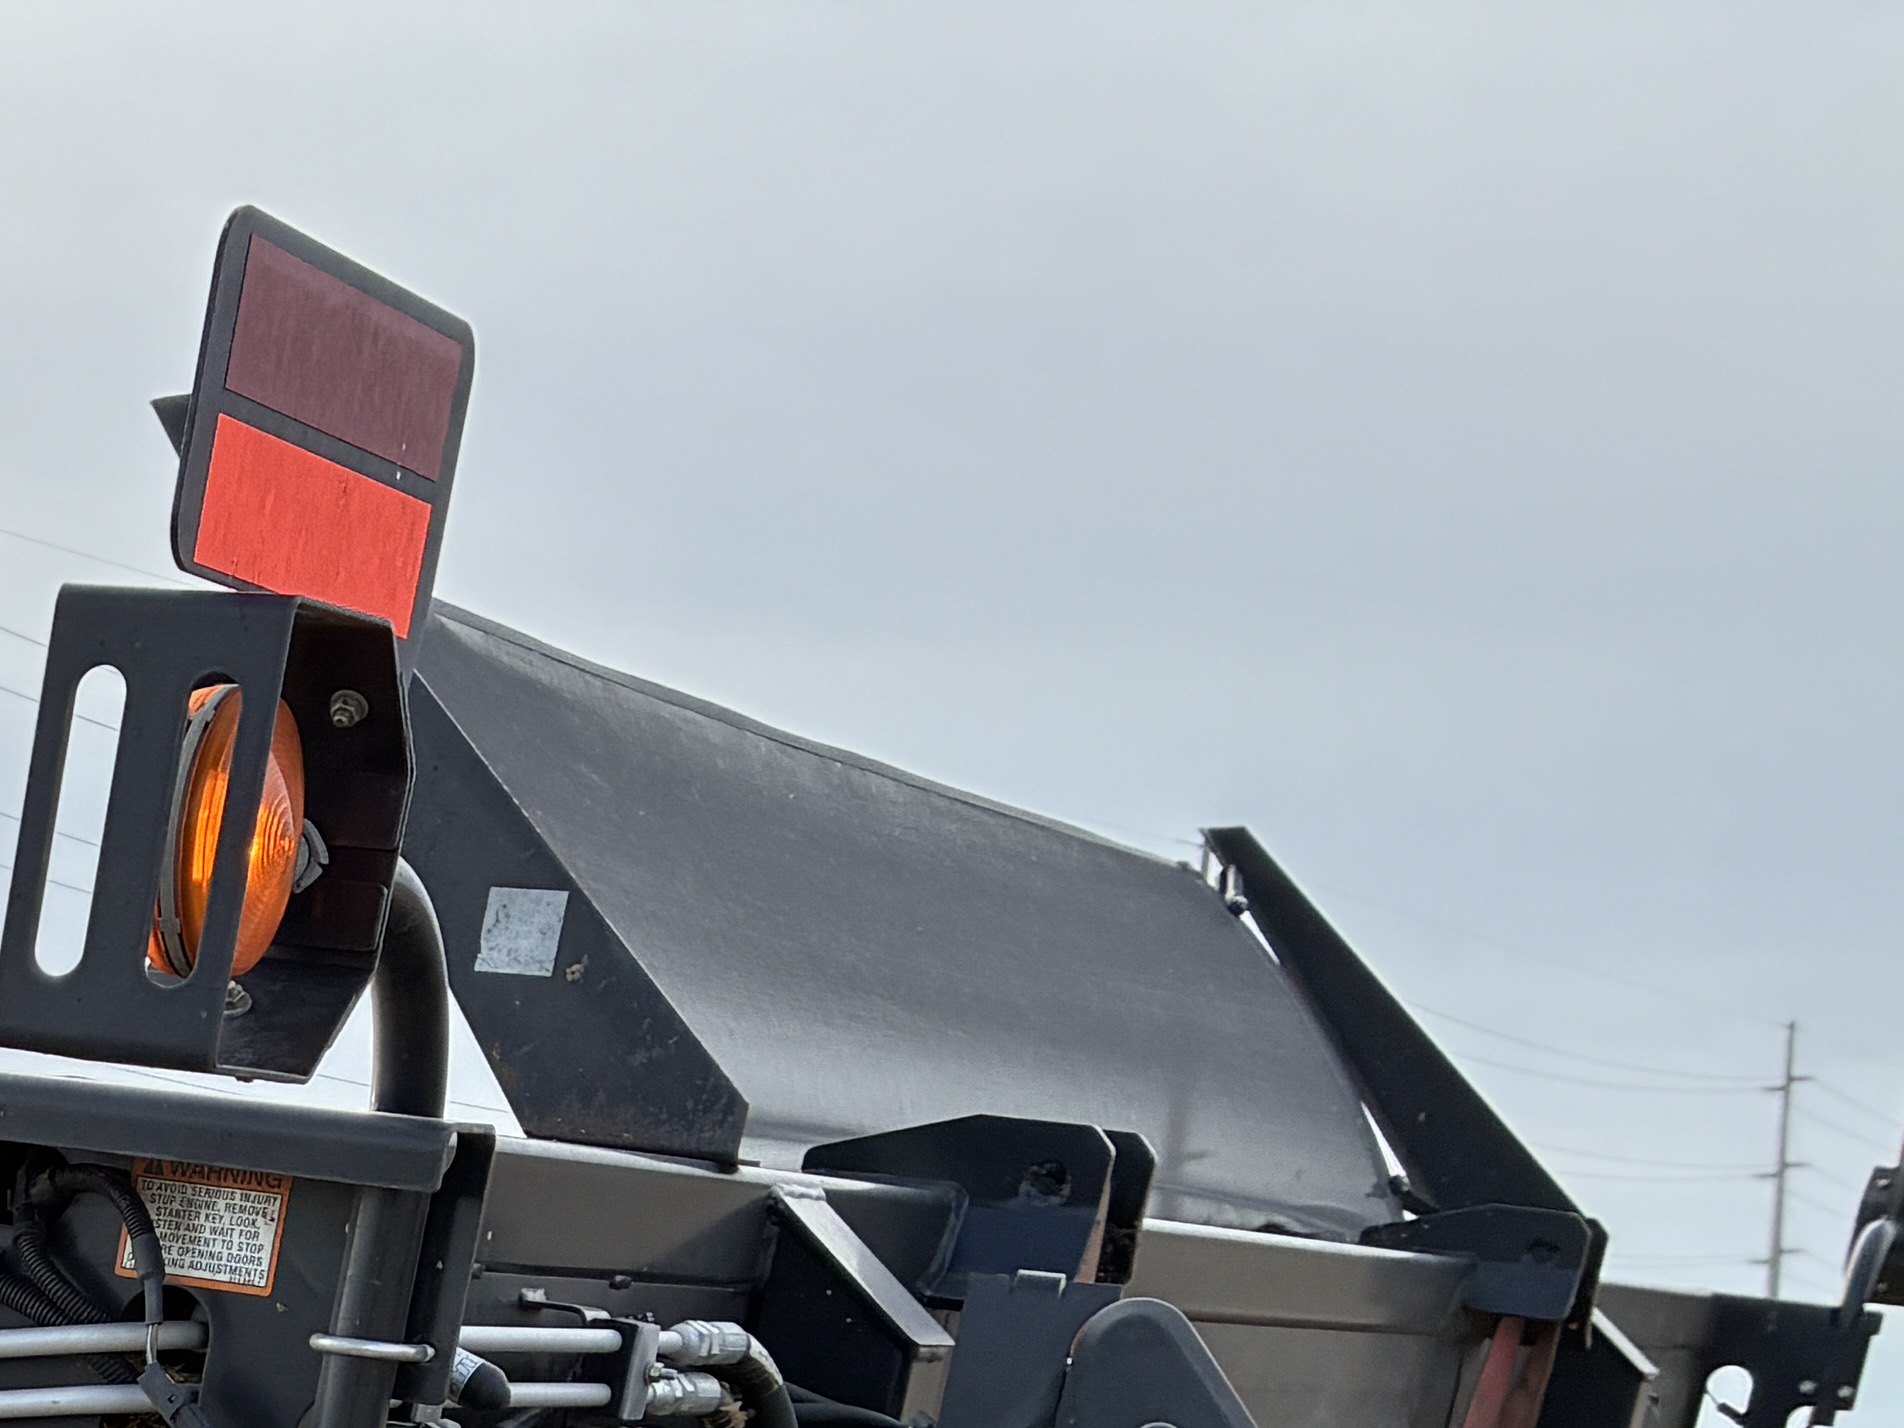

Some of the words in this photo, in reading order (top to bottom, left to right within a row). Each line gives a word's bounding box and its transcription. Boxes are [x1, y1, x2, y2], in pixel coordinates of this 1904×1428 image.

[173, 1160, 282, 1188] WARNING
[142, 1180, 153, 1191] TO
[156, 1183, 187, 1195] AVOID
[192, 1186, 235, 1200] SERIOUS
[240, 1192, 278, 1206] INJURY
[150, 1193, 176, 1205] STOP
[225, 1202, 269, 1218] REMOVE
[155, 1206, 201, 1221] STARTER
[160, 1231, 217, 1249] MOVEMENT
[221, 1240, 233, 1251] TO
[237, 1241, 265, 1254] STOP
[184, 1223, 206, 1235] AND
[210, 1227, 234, 1239] WAIT
[239, 1231, 260, 1242] FOR
[177, 1246, 223, 1262] OPENING
[227, 1253, 263, 1267] DOORS
[188, 1260, 265, 1280] ADJUSTMENTS
